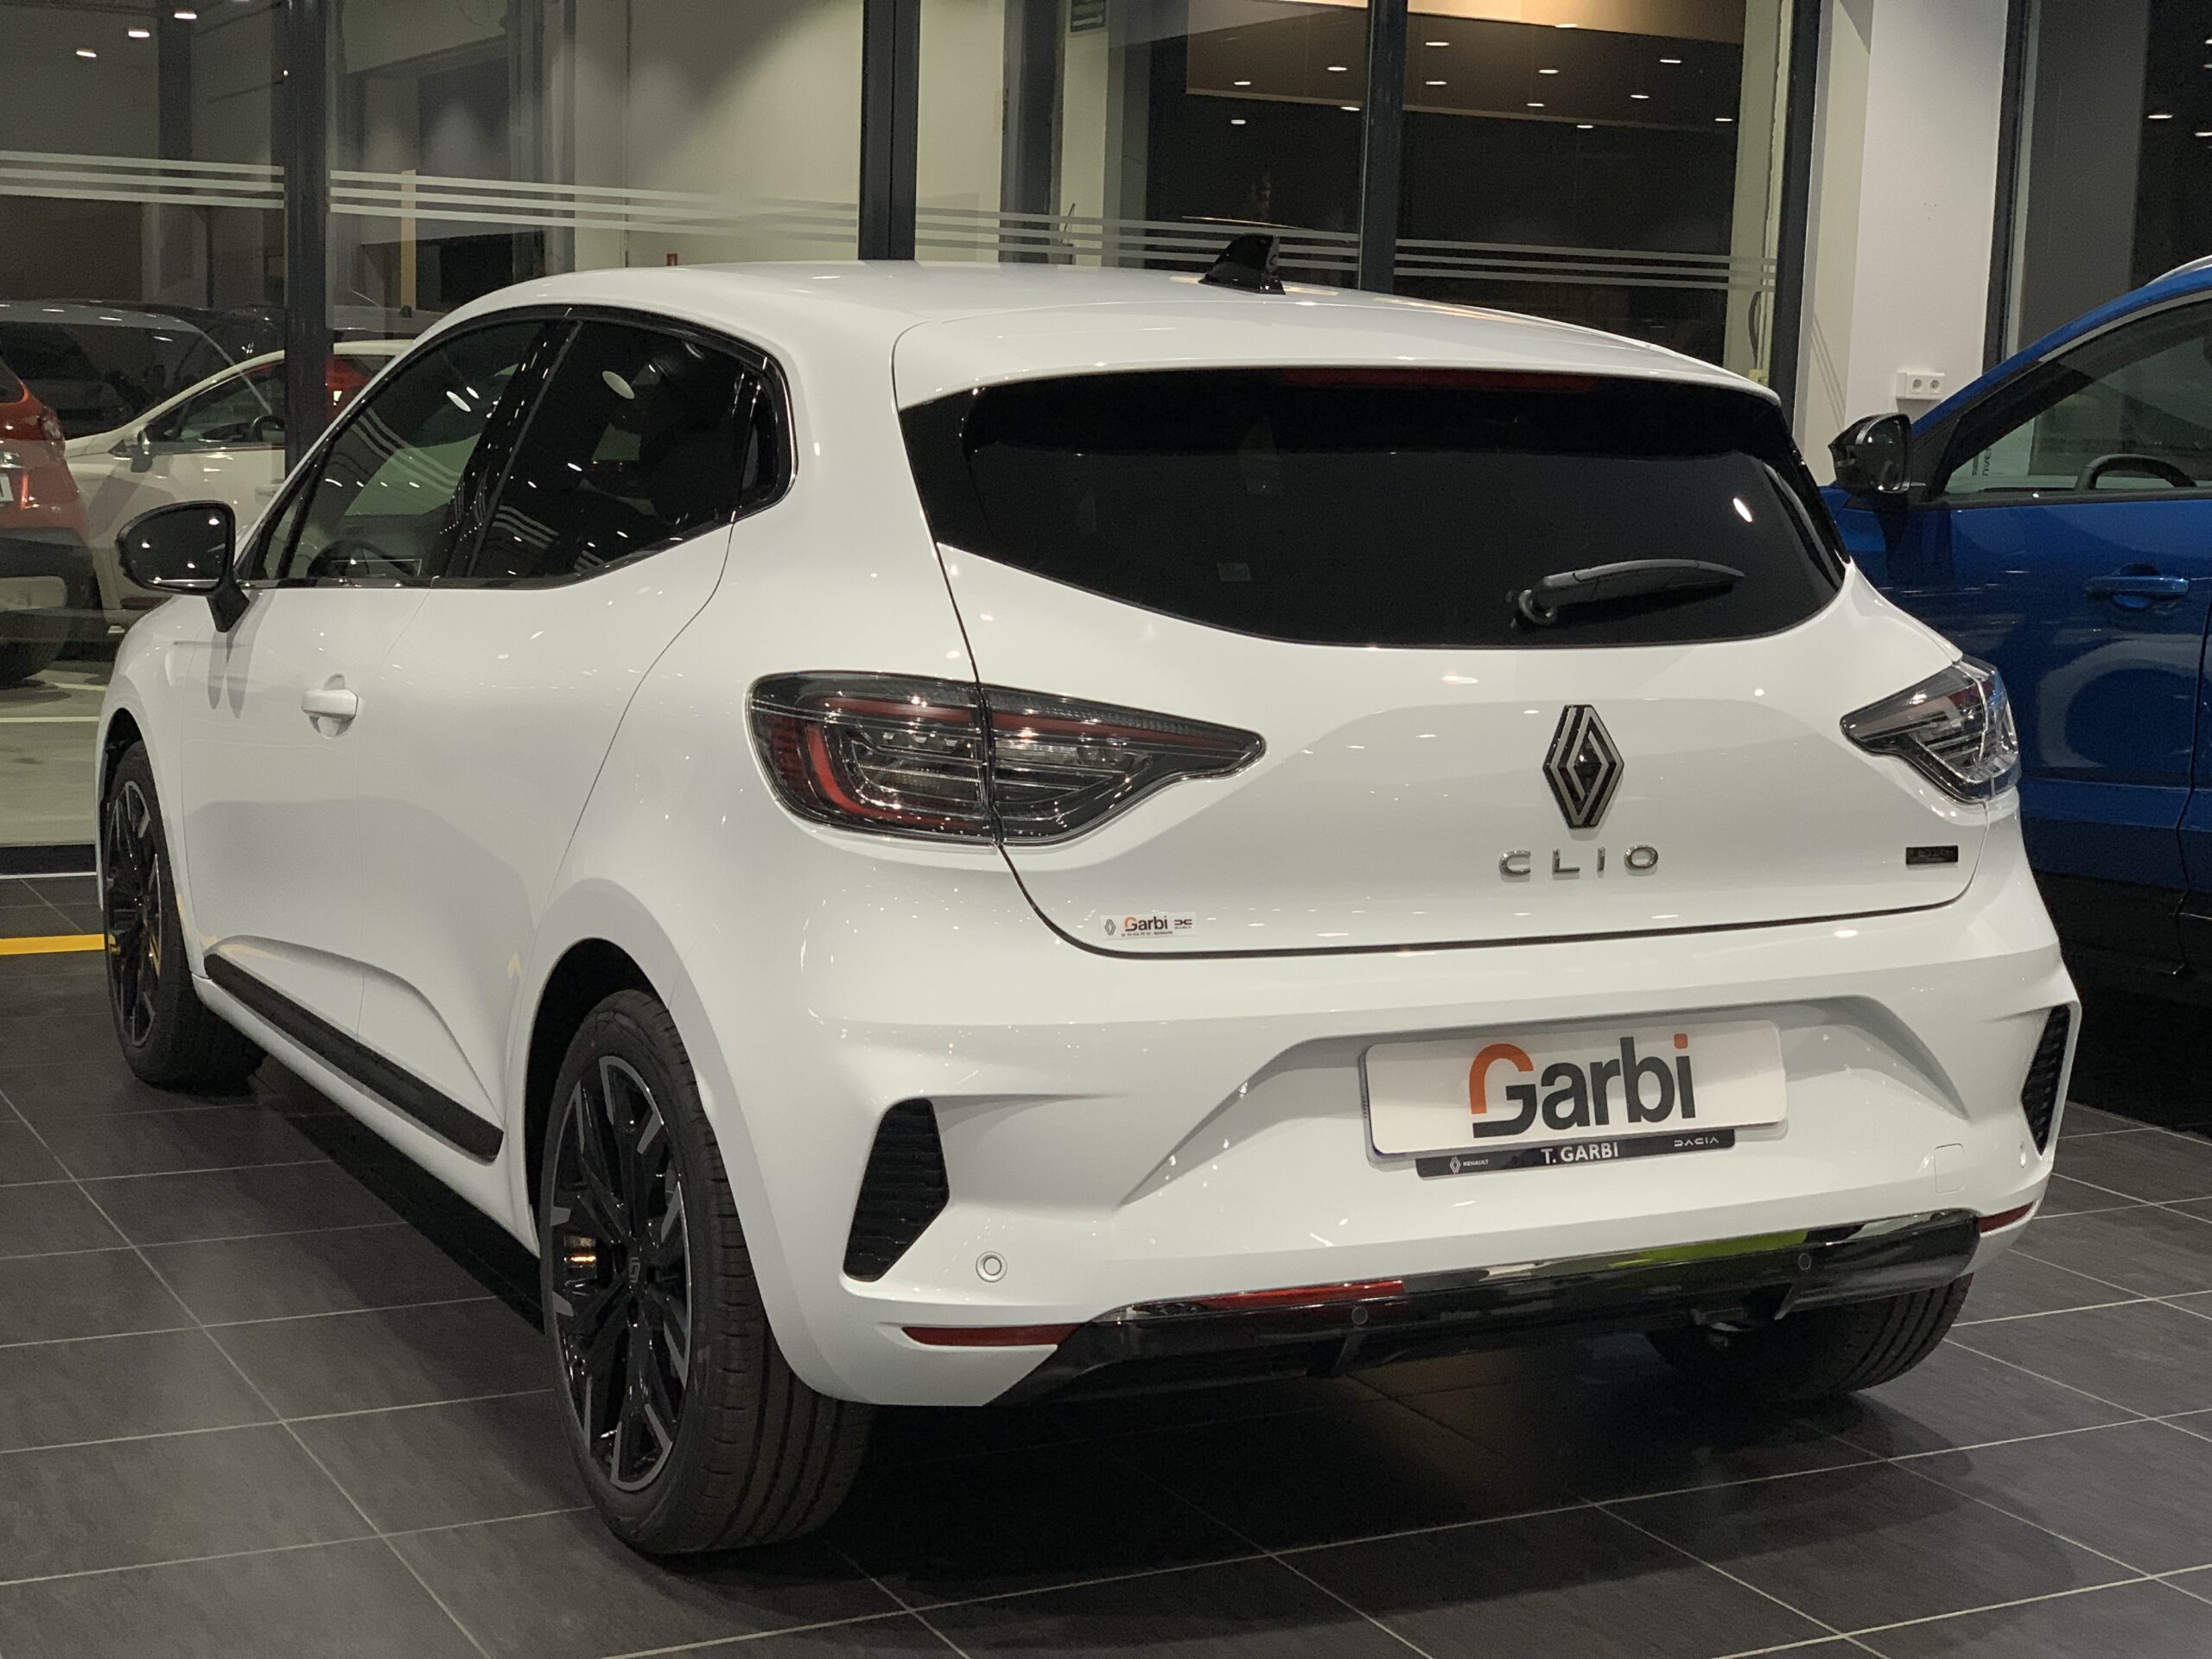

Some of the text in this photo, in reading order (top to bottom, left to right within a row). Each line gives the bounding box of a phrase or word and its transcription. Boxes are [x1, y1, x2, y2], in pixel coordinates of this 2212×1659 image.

[1499, 845, 1658, 875] CLIO
[1124, 916, 1168, 931] Garbi
[1469, 1033, 1695, 1138] Garbi
[1541, 1141, 1618, 1164] T. GARBI
[1674, 1137, 1719, 1147] DACIA
